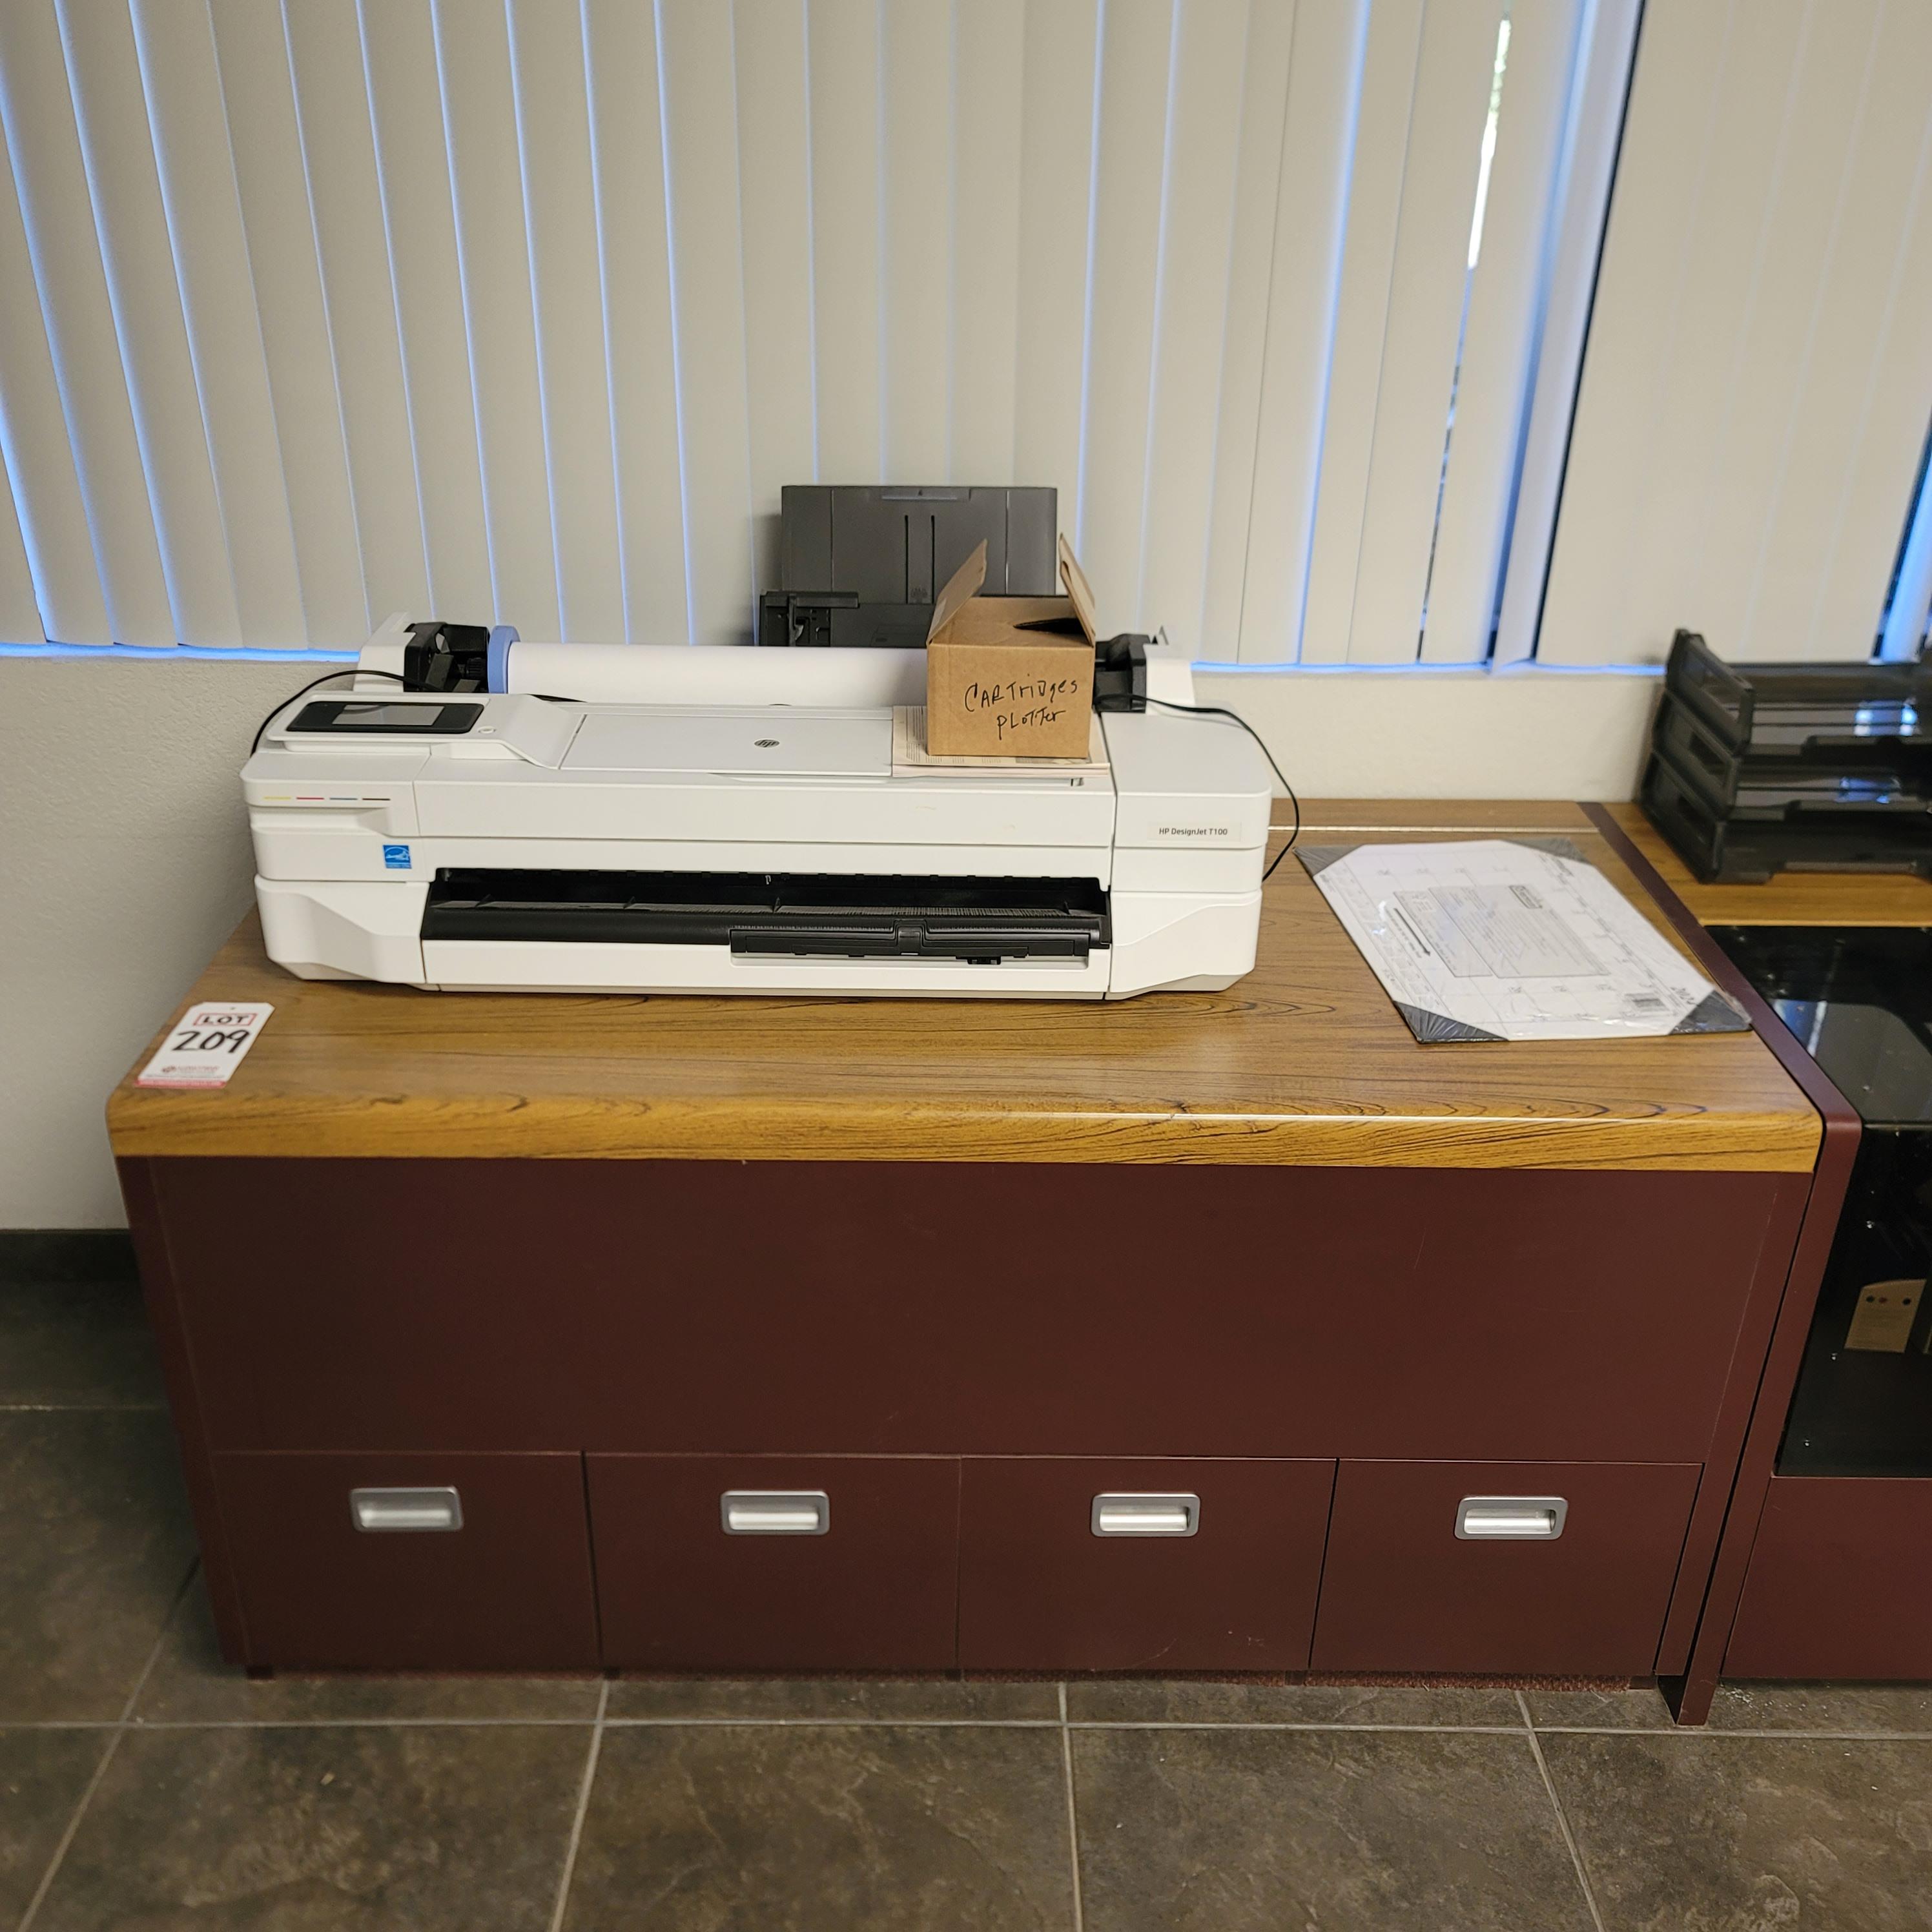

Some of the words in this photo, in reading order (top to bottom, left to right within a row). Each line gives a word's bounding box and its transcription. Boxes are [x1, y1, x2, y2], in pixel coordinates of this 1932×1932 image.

[1171, 828, 1206, 837] DesignJet
[203, 1015, 249, 1023] LOT
[172, 1029, 250, 1053] 209
